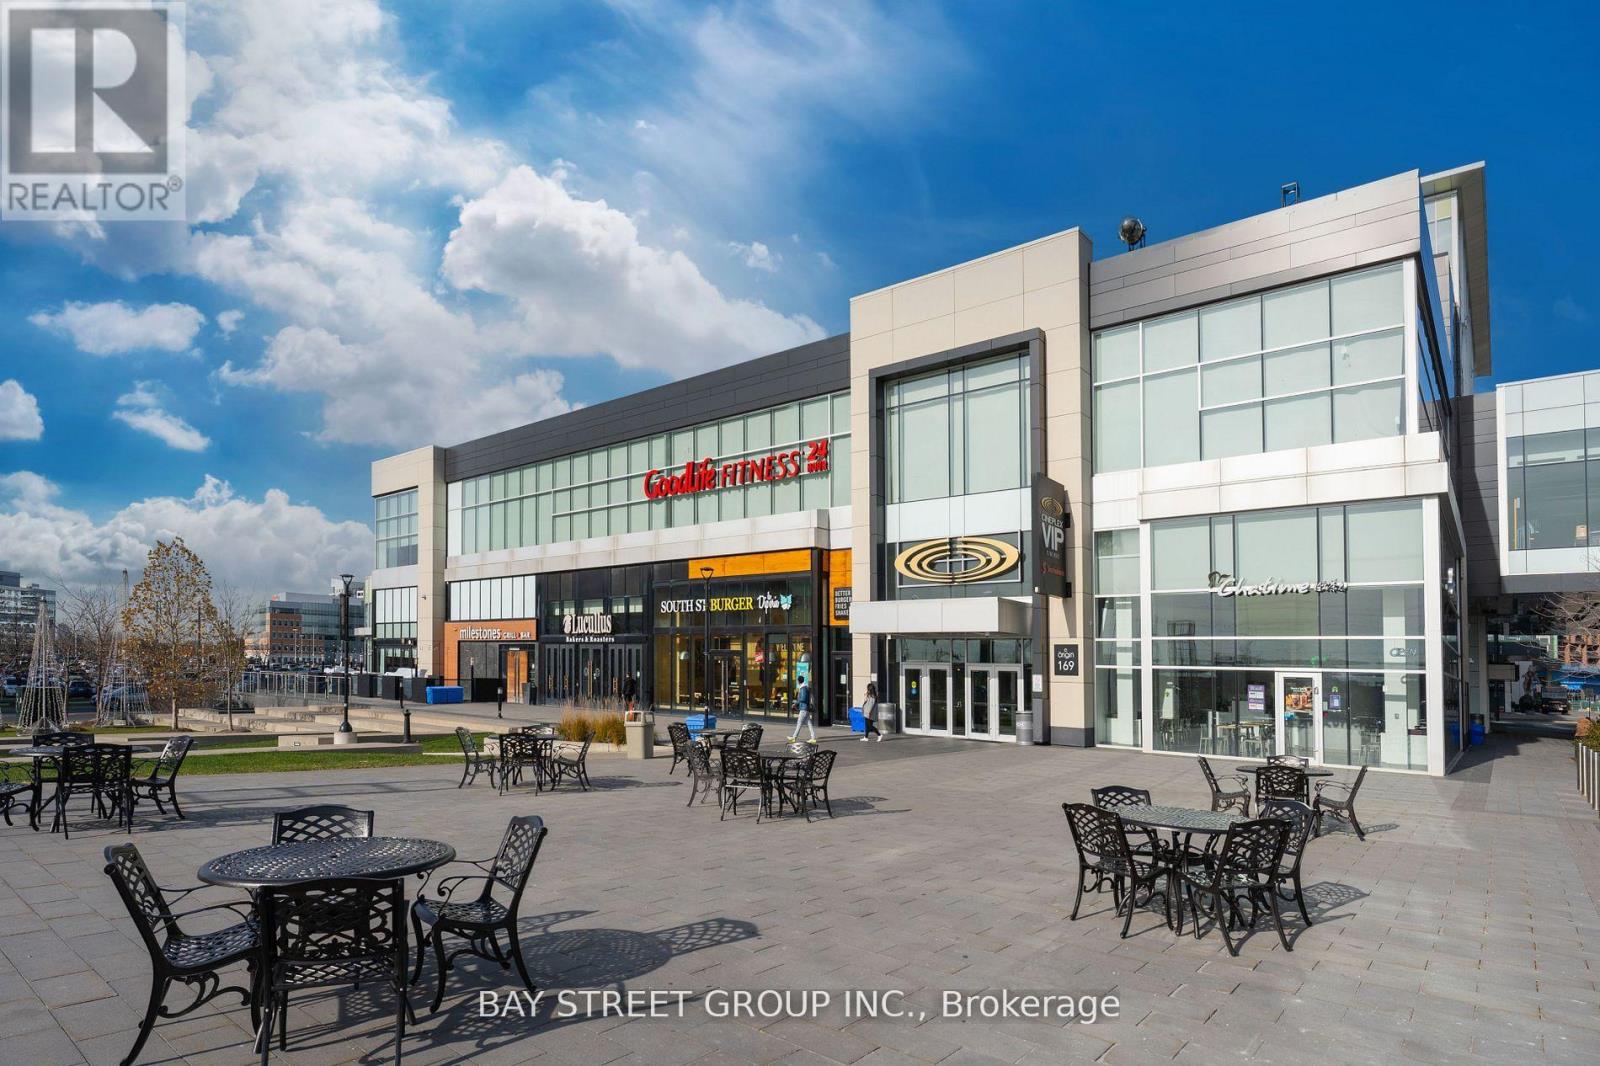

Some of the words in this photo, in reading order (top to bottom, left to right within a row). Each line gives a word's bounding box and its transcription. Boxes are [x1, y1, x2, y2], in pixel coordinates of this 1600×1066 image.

[807, 438, 828, 461] 24
[720, 450, 800, 488] FITNESS
[1041, 522, 1065, 551] VIP
[1217, 577, 1310, 597] Chatime
[660, 599, 694, 613] SOUTH
[710, 596, 753, 611] BURGER
[459, 626, 501, 639] milestones
[572, 612, 612, 634] Lucullus
[1058, 660, 1075, 671] 169
